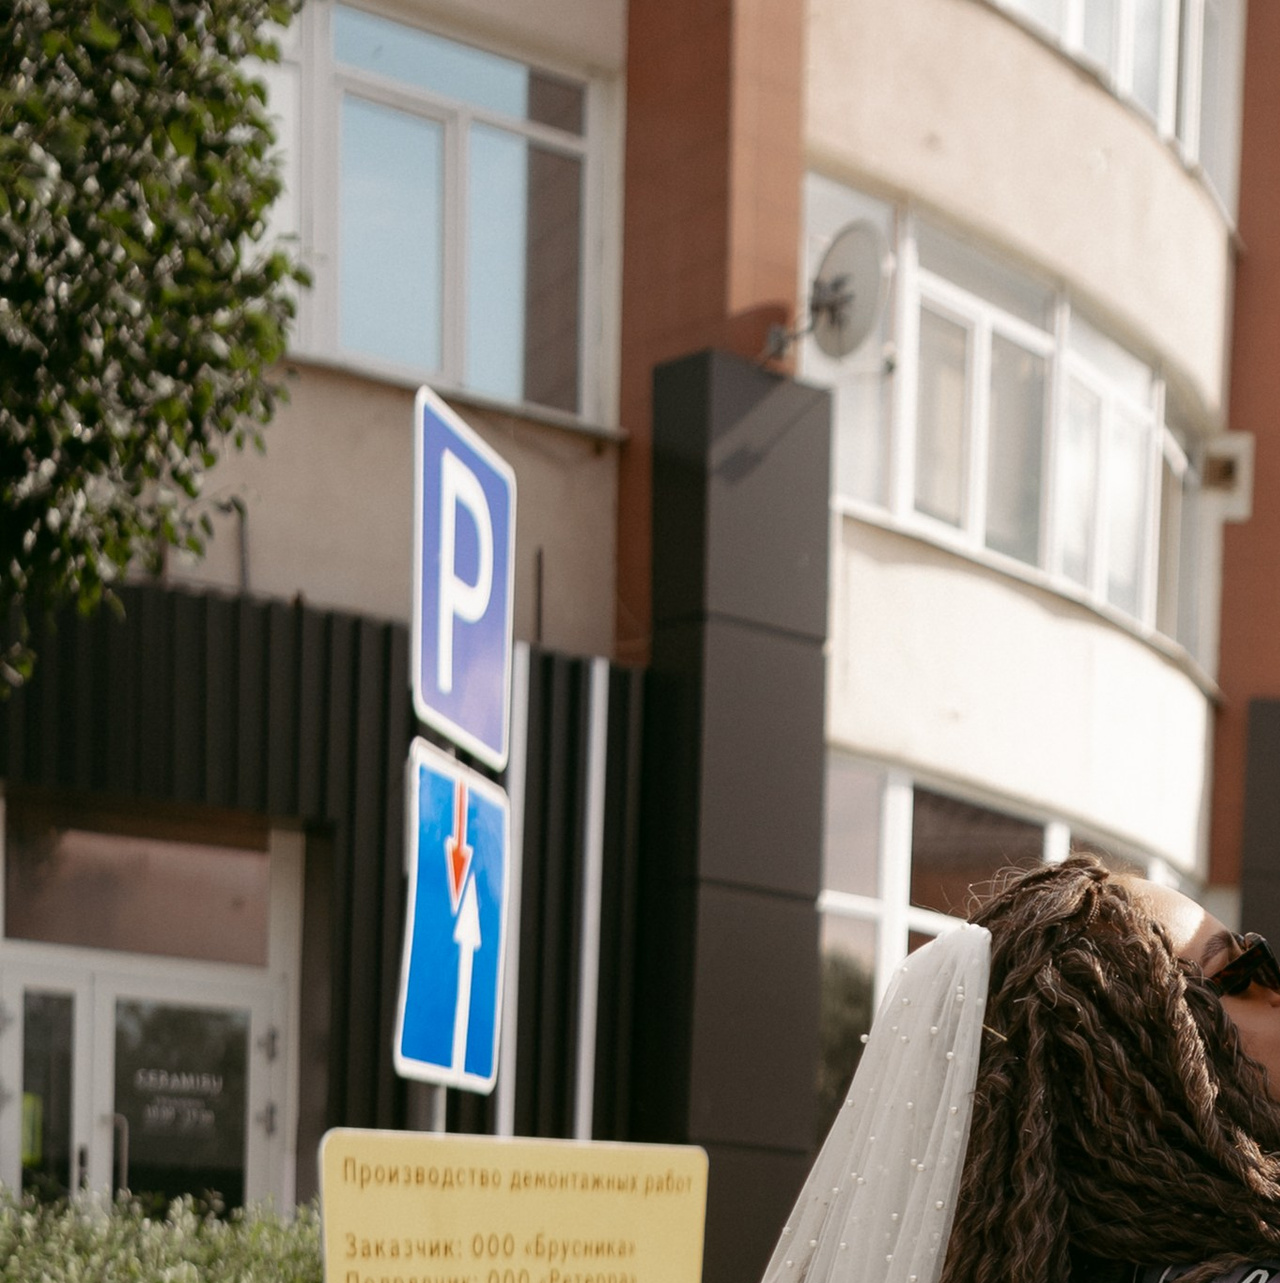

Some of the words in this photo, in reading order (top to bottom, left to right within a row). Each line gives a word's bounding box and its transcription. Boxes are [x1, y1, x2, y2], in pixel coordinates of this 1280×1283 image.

[437, 447, 494, 694] P
[343, 1157, 502, 1190] Производство
[510, 1168, 638, 1195] демонтажных
[644, 1169, 694, 1199] работ
[345, 1232, 463, 1259] Заказчик:
[472, 1232, 516, 1259] ООО
[525, 1232, 637, 1264] «Брусника»
